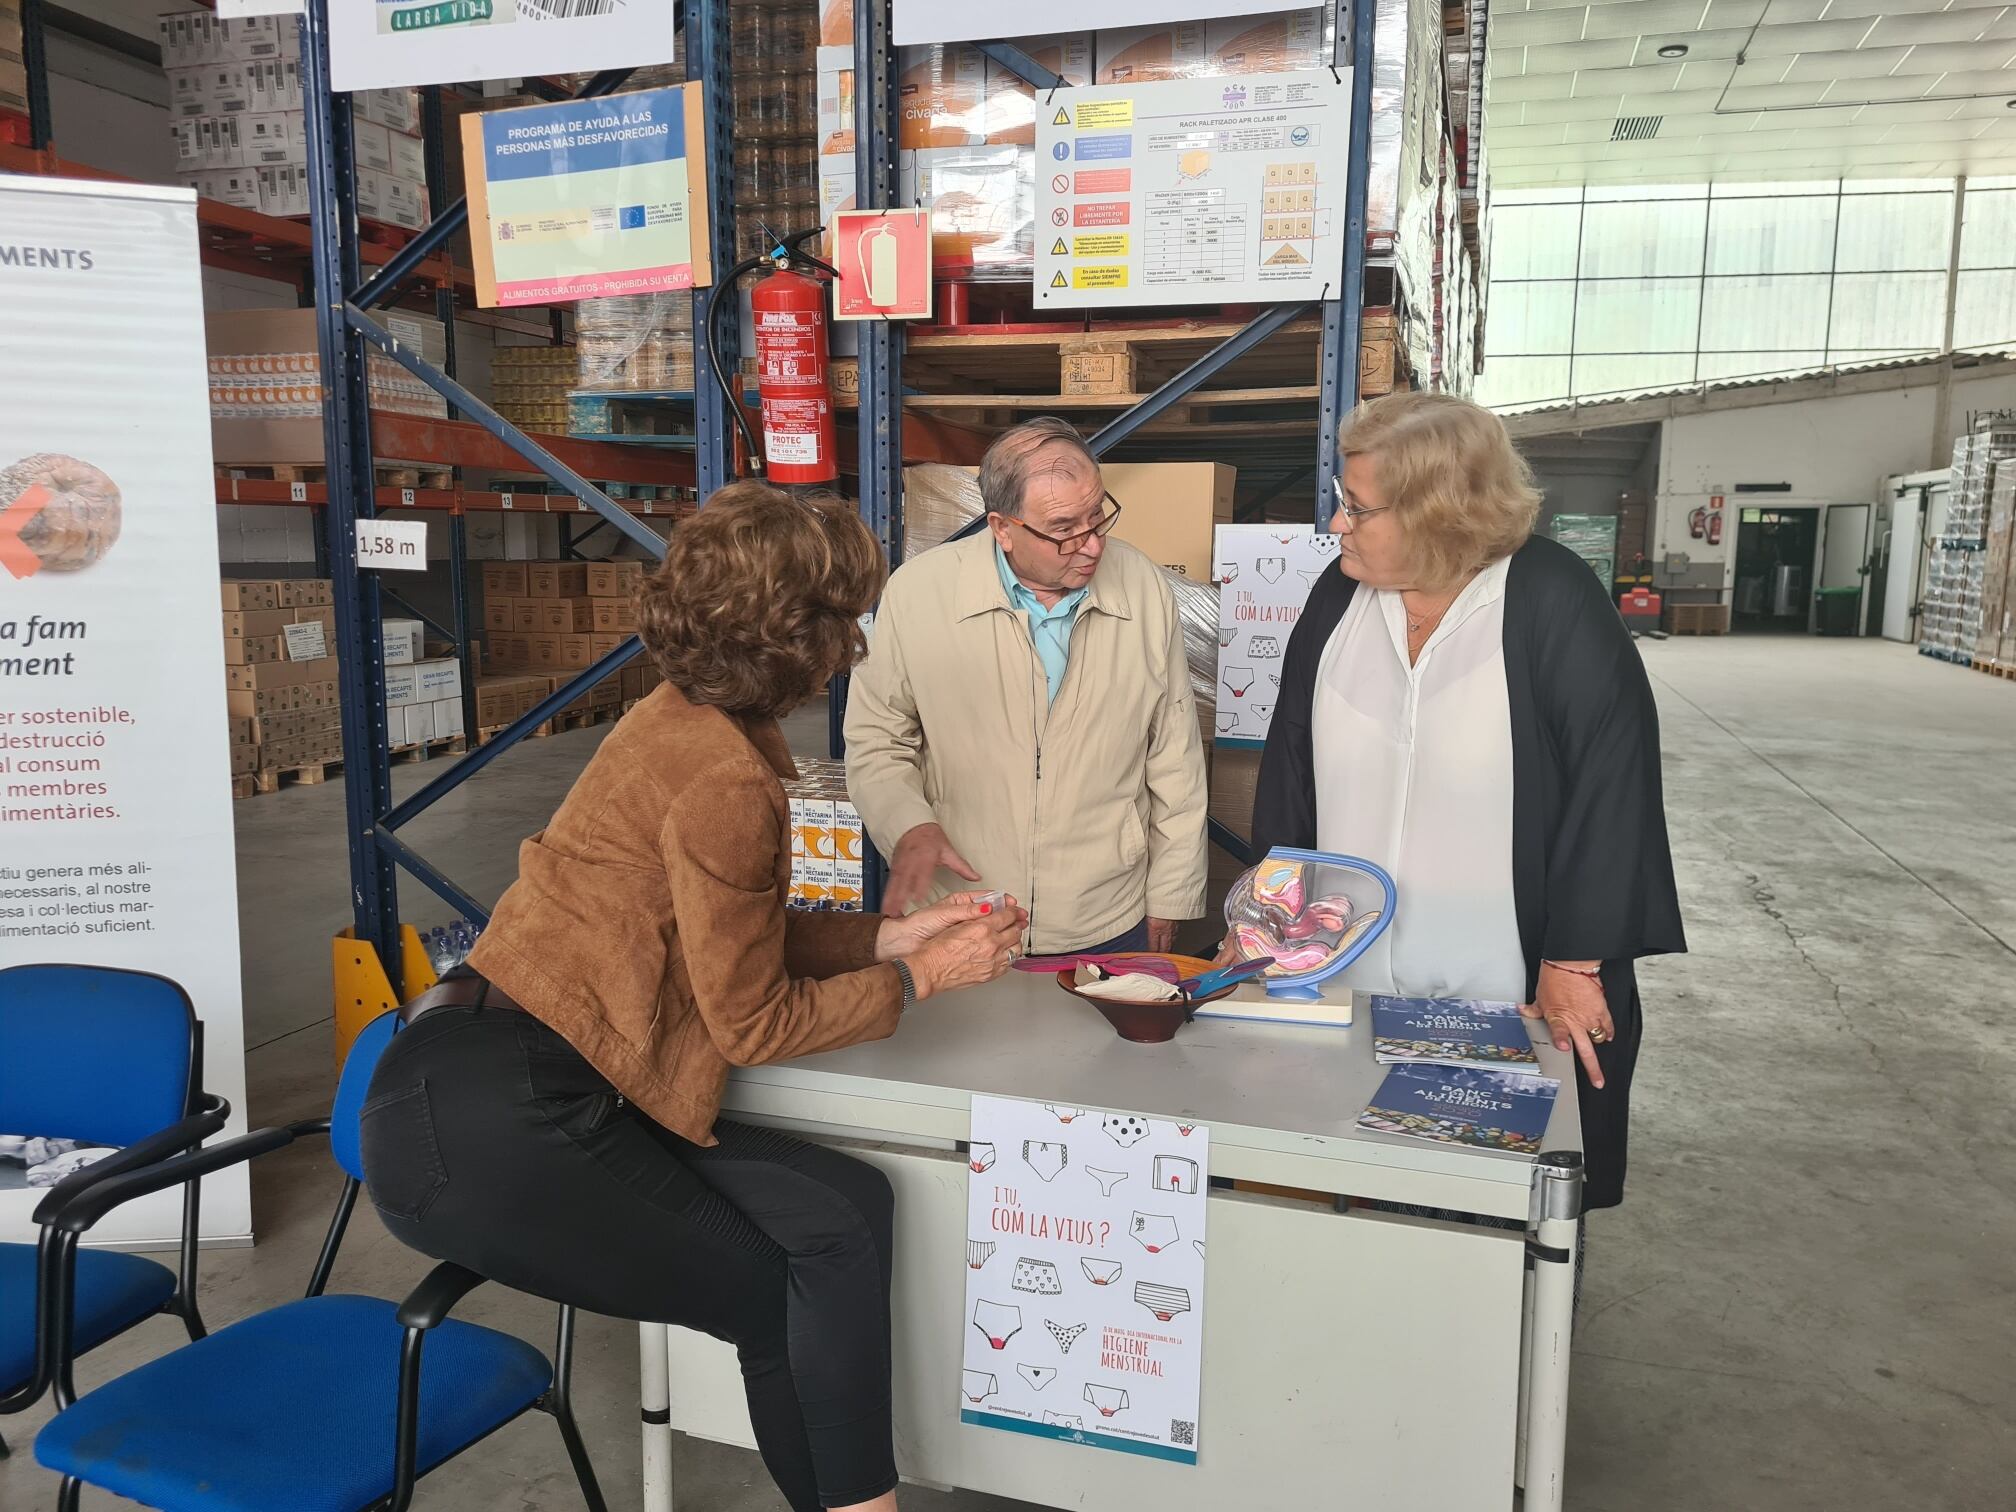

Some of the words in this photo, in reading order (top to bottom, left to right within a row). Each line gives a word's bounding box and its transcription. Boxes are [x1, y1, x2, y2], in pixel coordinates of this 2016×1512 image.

[396, 7, 441, 28] LARGA
[452, 0, 487, 20] VIDA
[508, 123, 566, 139] PROGRAMA
[569, 121, 582, 132] DE
[585, 116, 619, 130] AYUDA
[623, 115, 630, 126] A
[632, 111, 651, 124] LAS
[496, 139, 551, 155] PERSONAS
[553, 136, 575, 148] MÁS
[578, 123, 668, 146] DESFAVORECIDAS
[0, 245, 94, 270] MENTS
[503, 285, 549, 300] ALIMENTOS
[552, 283, 598, 296] GRATUITOS
[604, 278, 648, 291] PROHIBIDA
[650, 276, 661, 286] SU
[662, 272, 689, 285] VENTA
[773, 435, 801, 444] PROTEC
[293, 488, 303, 498] 11
[404, 492, 413, 502] 12
[503, 496, 511, 506] 13
[359, 536, 394, 556] 1,58
[400, 541, 415, 555] m
[1235, 605, 1256, 621] COM
[1261, 606, 1271, 621] LA
[22, 615, 86, 647] fam
[0, 652, 74, 676] ment
[21, 706, 136, 725] sostenible,
[0, 730, 105, 749] destrucció
[17, 758, 100, 772] consum
[8, 779, 107, 796] membres
[2, 803, 120, 821] imentàries.
[26, 866, 83, 881] genera
[89, 862, 122, 876] més
[128, 862, 152, 874] ali-
[87, 882, 99, 895] al
[105, 882, 151, 894] nostre
[29, 905, 34, 916] i
[38, 901, 114, 916] col·lectius
[120, 901, 154, 912] mar-
[86, 919, 155, 933] suficient.
[1404, 1020, 1492, 1029] ALIMENTS
[1414, 1089, 1512, 1109] ALIMENTS
[1441, 1085, 1492, 1098] BANC
[994, 1186, 1000, 1202] I
[991, 1207, 1024, 1235] COM
[1031, 1213, 1048, 1239] LA
[1055, 1217, 1094, 1245] VIUS
[1100, 1221, 1111, 1248] ?
[1103, 1334, 1148, 1357] HIGIENE
[1136, 1331, 1168, 1342] INTERNACIONAL
[1101, 1352, 1164, 1377] MENSTRUAL
